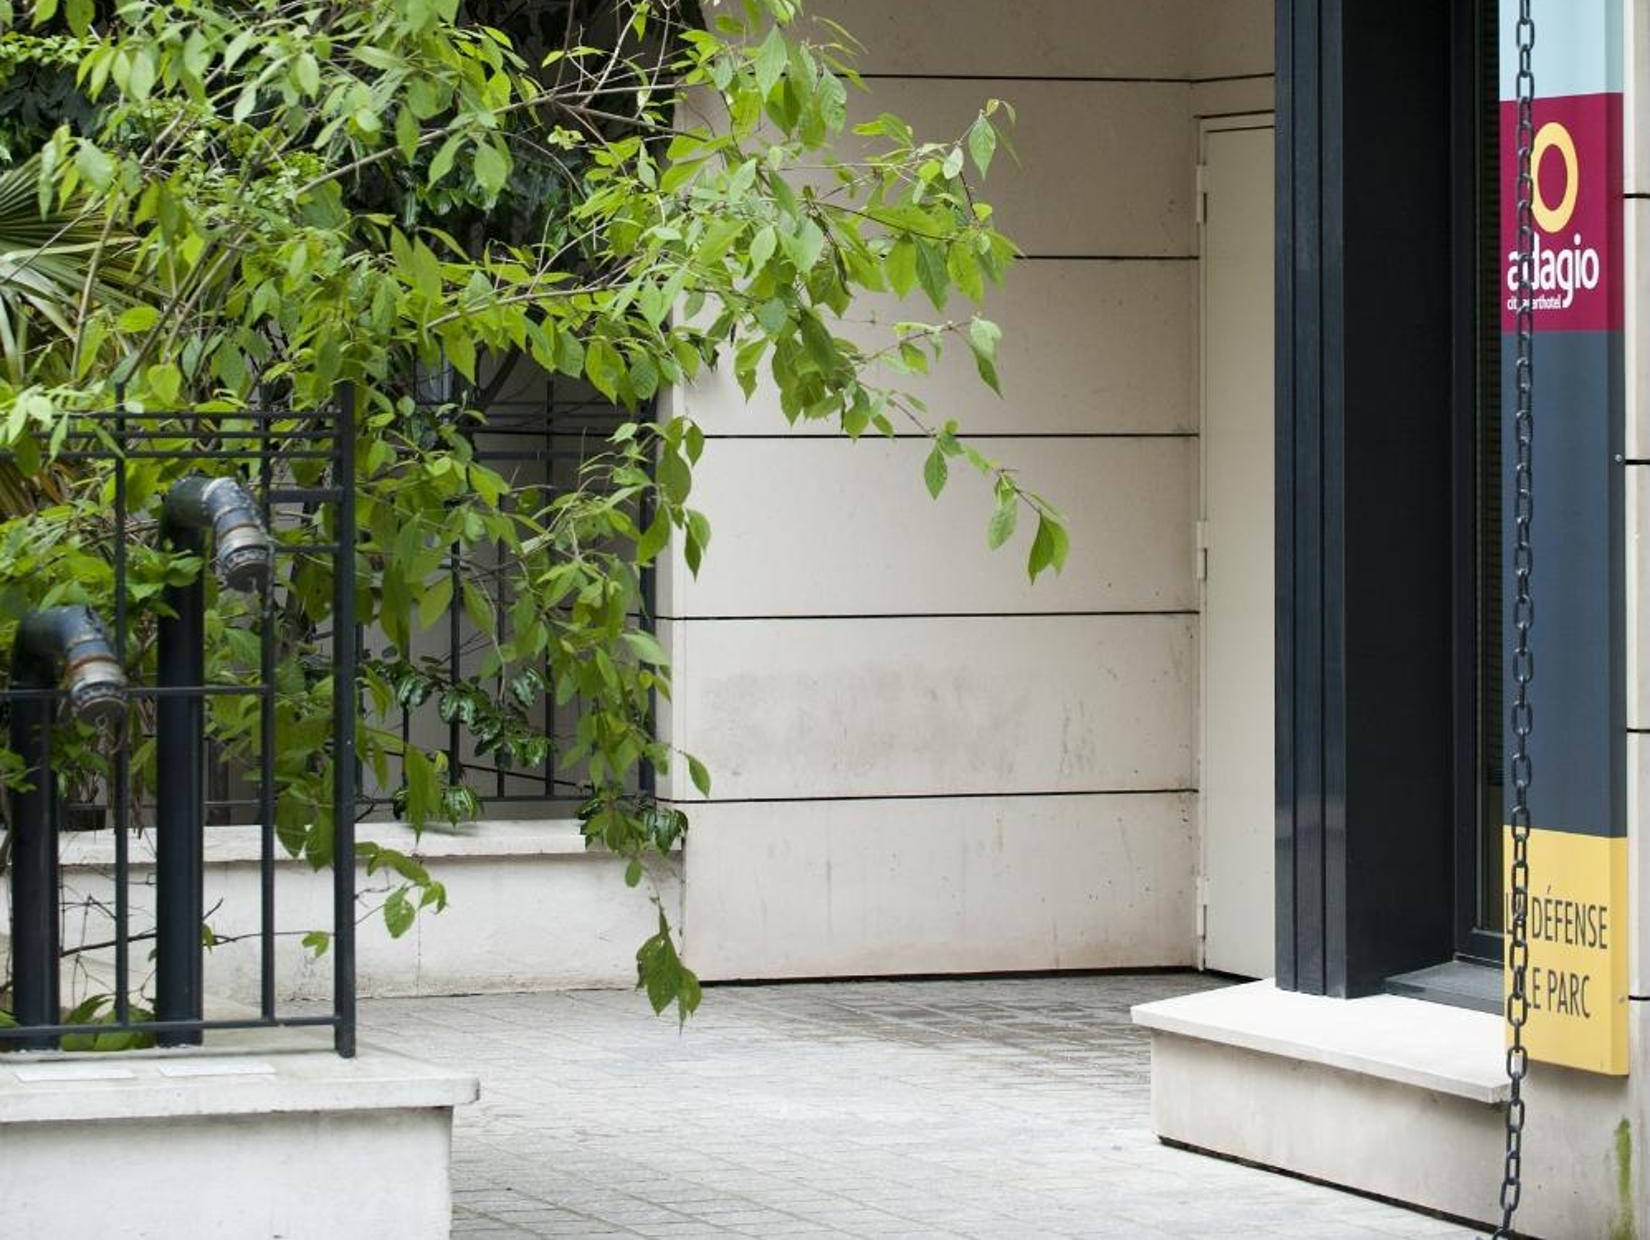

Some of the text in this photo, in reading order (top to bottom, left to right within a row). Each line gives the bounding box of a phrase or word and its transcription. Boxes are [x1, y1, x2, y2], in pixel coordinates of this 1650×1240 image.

[1531, 884, 1608, 950] DÉFENSE
[1523, 966, 1591, 1018] E PARC
